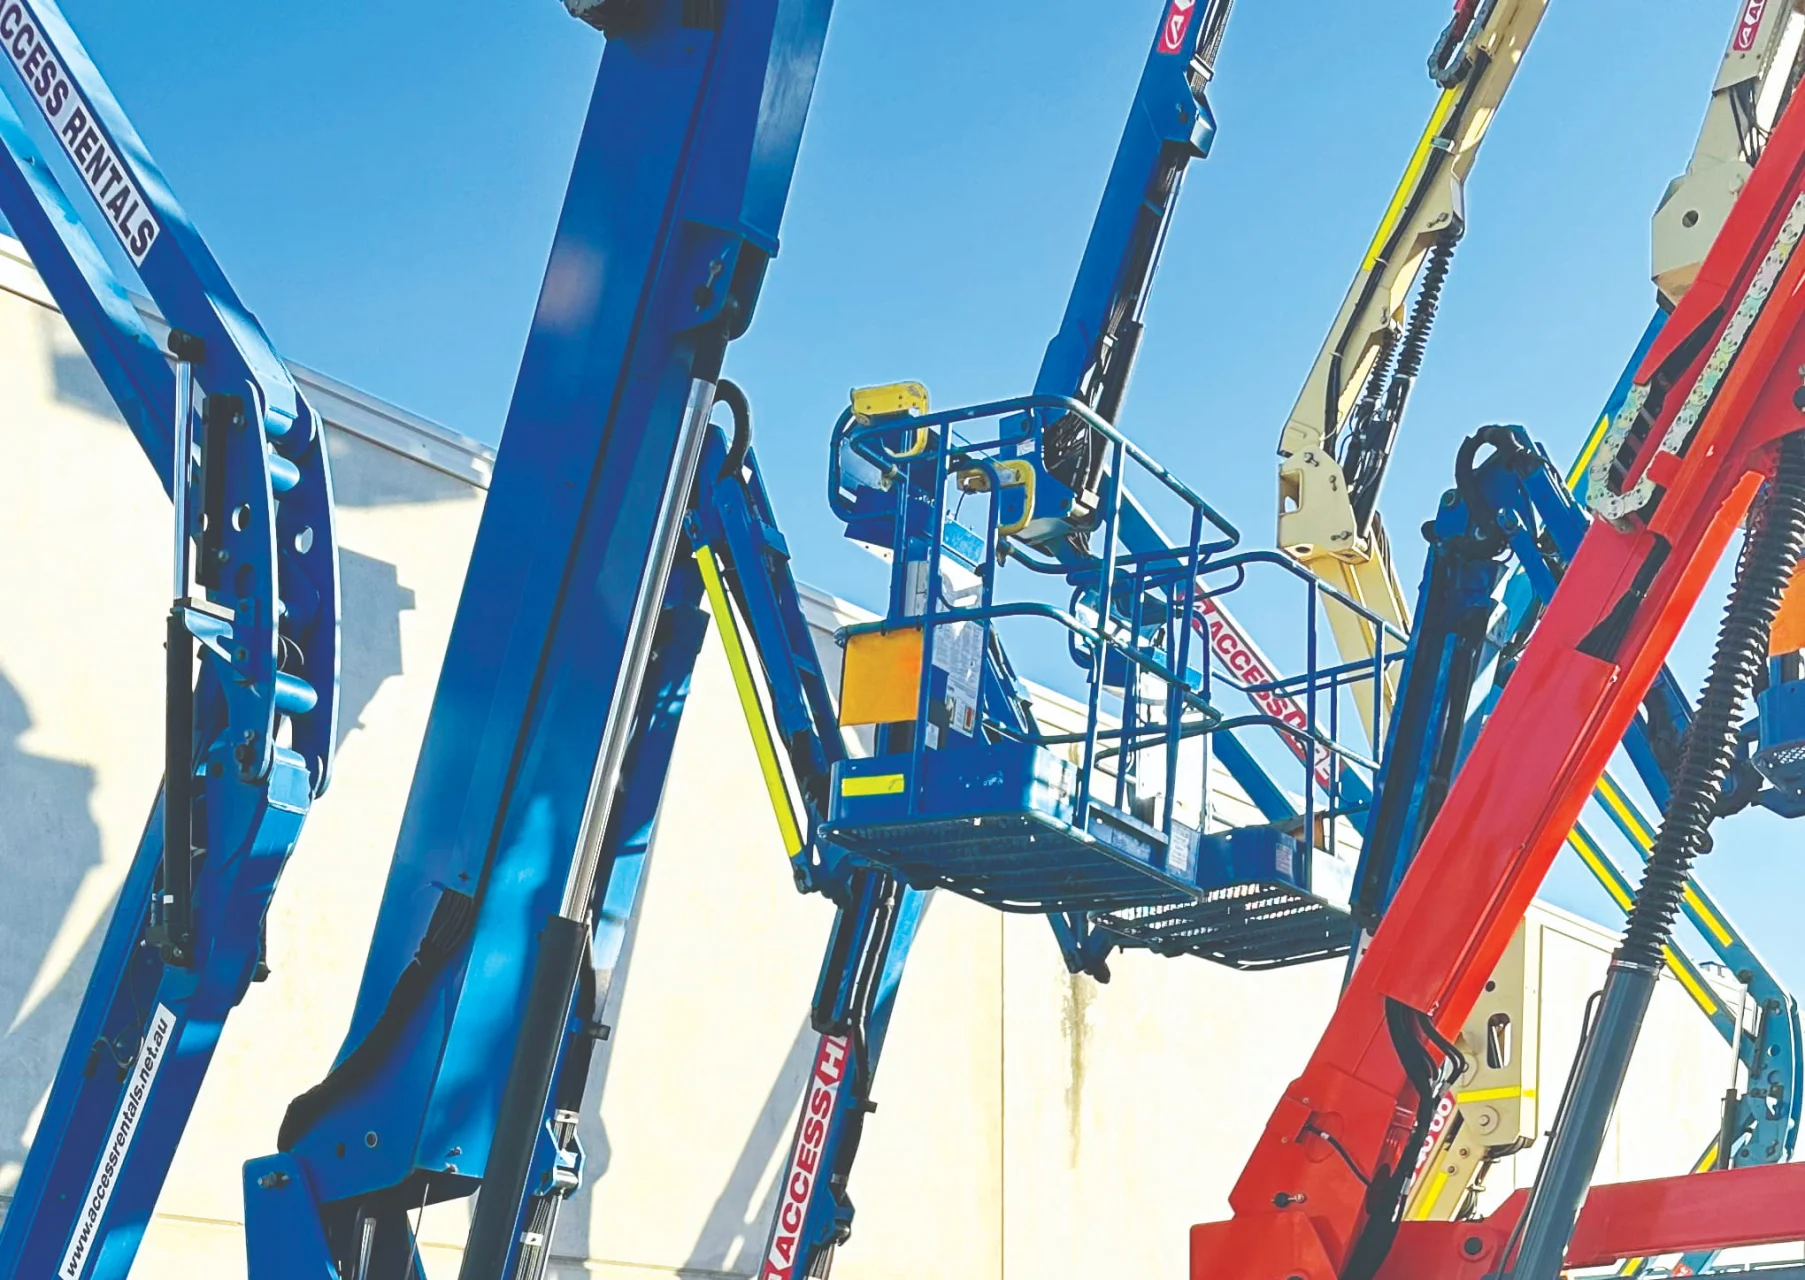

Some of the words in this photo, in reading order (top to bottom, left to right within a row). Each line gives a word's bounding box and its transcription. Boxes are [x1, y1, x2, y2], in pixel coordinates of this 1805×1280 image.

[0, 0, 69, 117] CCESS
[61, 105, 155, 257] RENTALS
[67, 1016, 169, 1277] www.accessrentals.net.au
[774, 1086, 833, 1262] ACCESS
